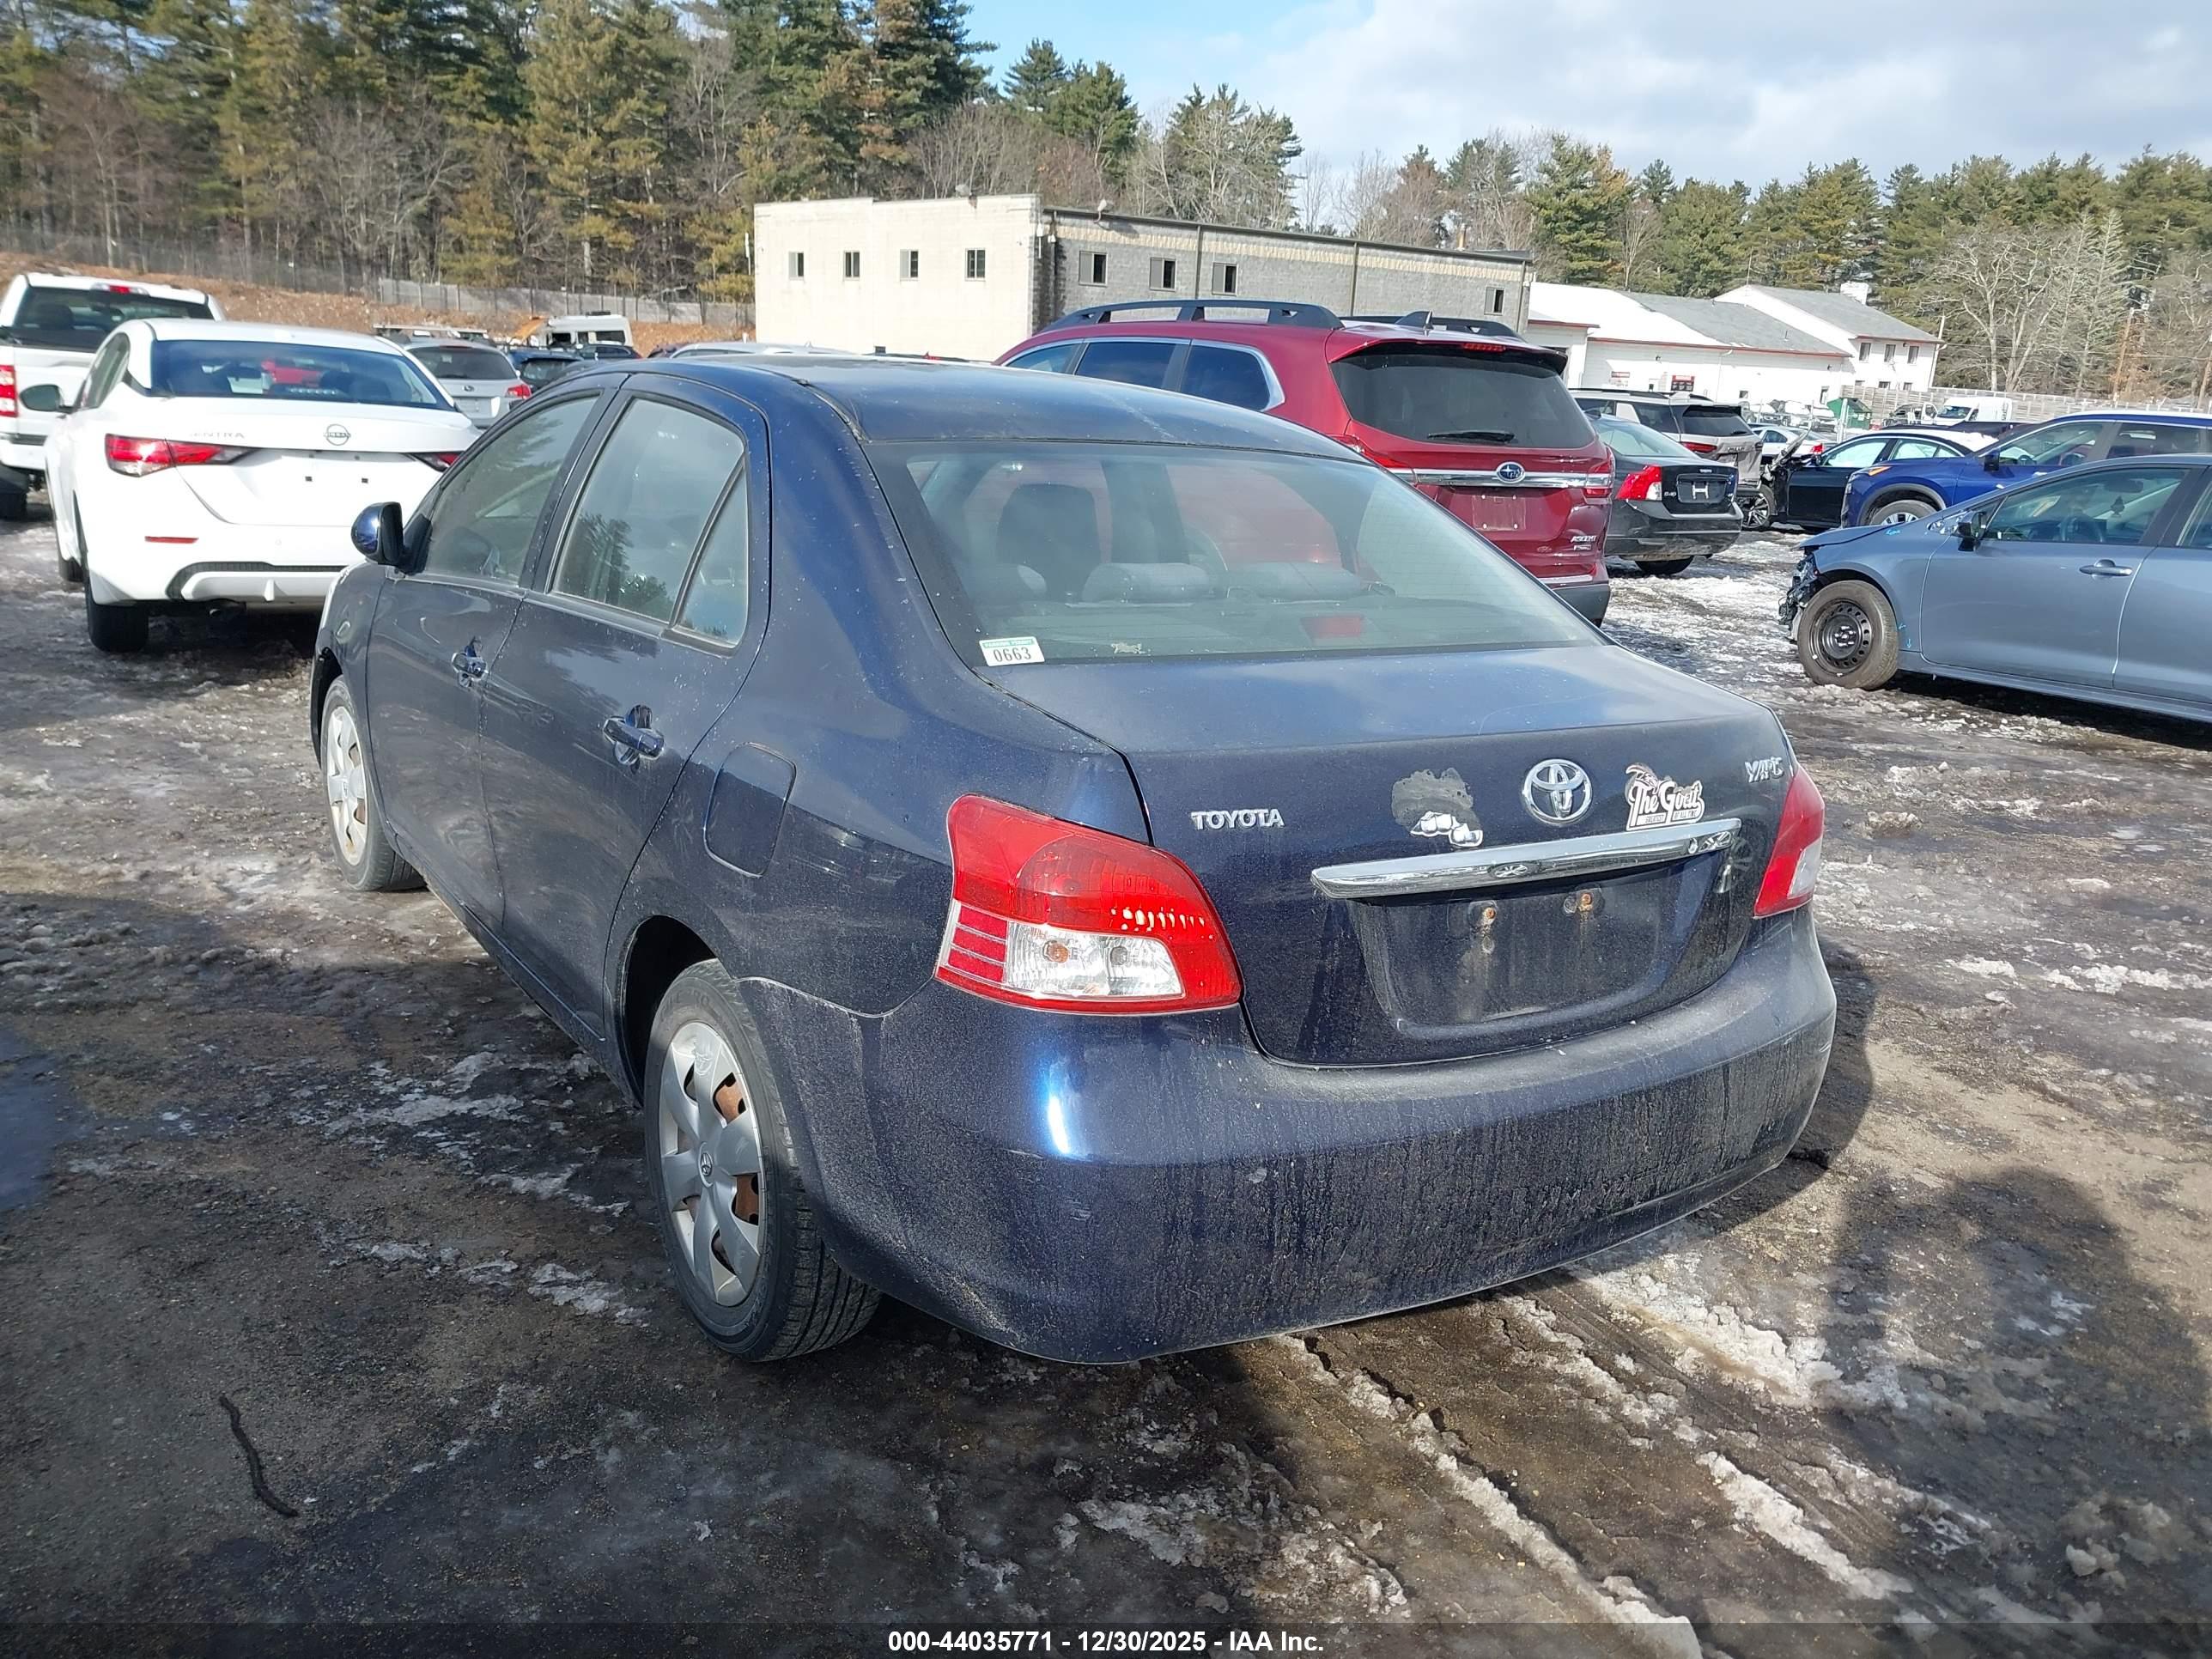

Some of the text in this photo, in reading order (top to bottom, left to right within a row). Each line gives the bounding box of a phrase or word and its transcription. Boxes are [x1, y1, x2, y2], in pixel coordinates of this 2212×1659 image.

[993, 647, 1031, 662] 0663
[1628, 780, 1660, 827] The
[1190, 808, 1285, 830] TOYOTA
